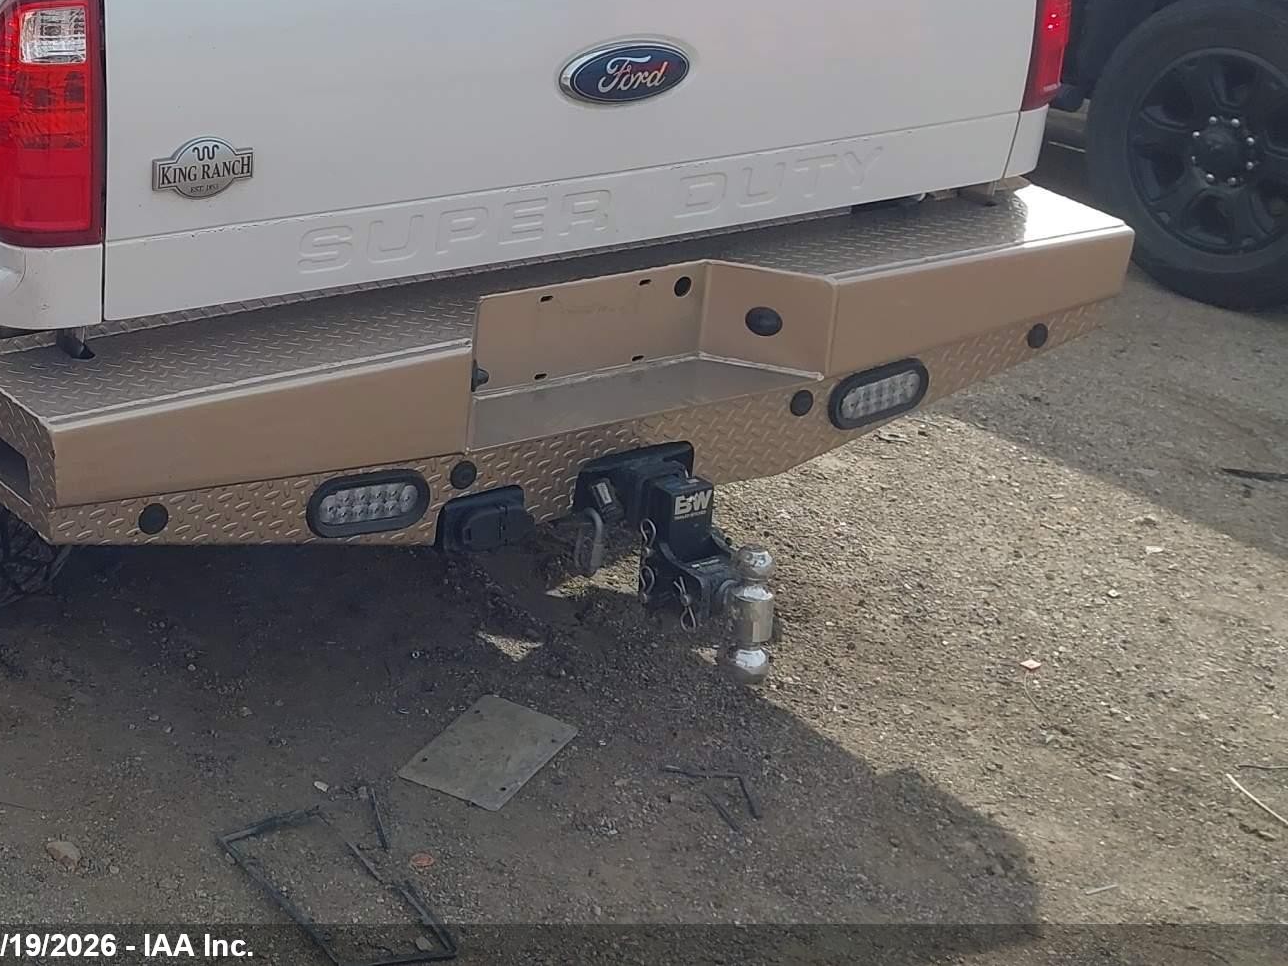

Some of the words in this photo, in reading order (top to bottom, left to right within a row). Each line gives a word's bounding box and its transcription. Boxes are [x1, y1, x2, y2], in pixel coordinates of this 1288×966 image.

[597, 55, 669, 93] Ford
[161, 165, 197, 185] KING
[201, 155, 251, 180] RANCH
[297, 187, 614, 275] SUPER
[672, 144, 885, 220] DUTY
